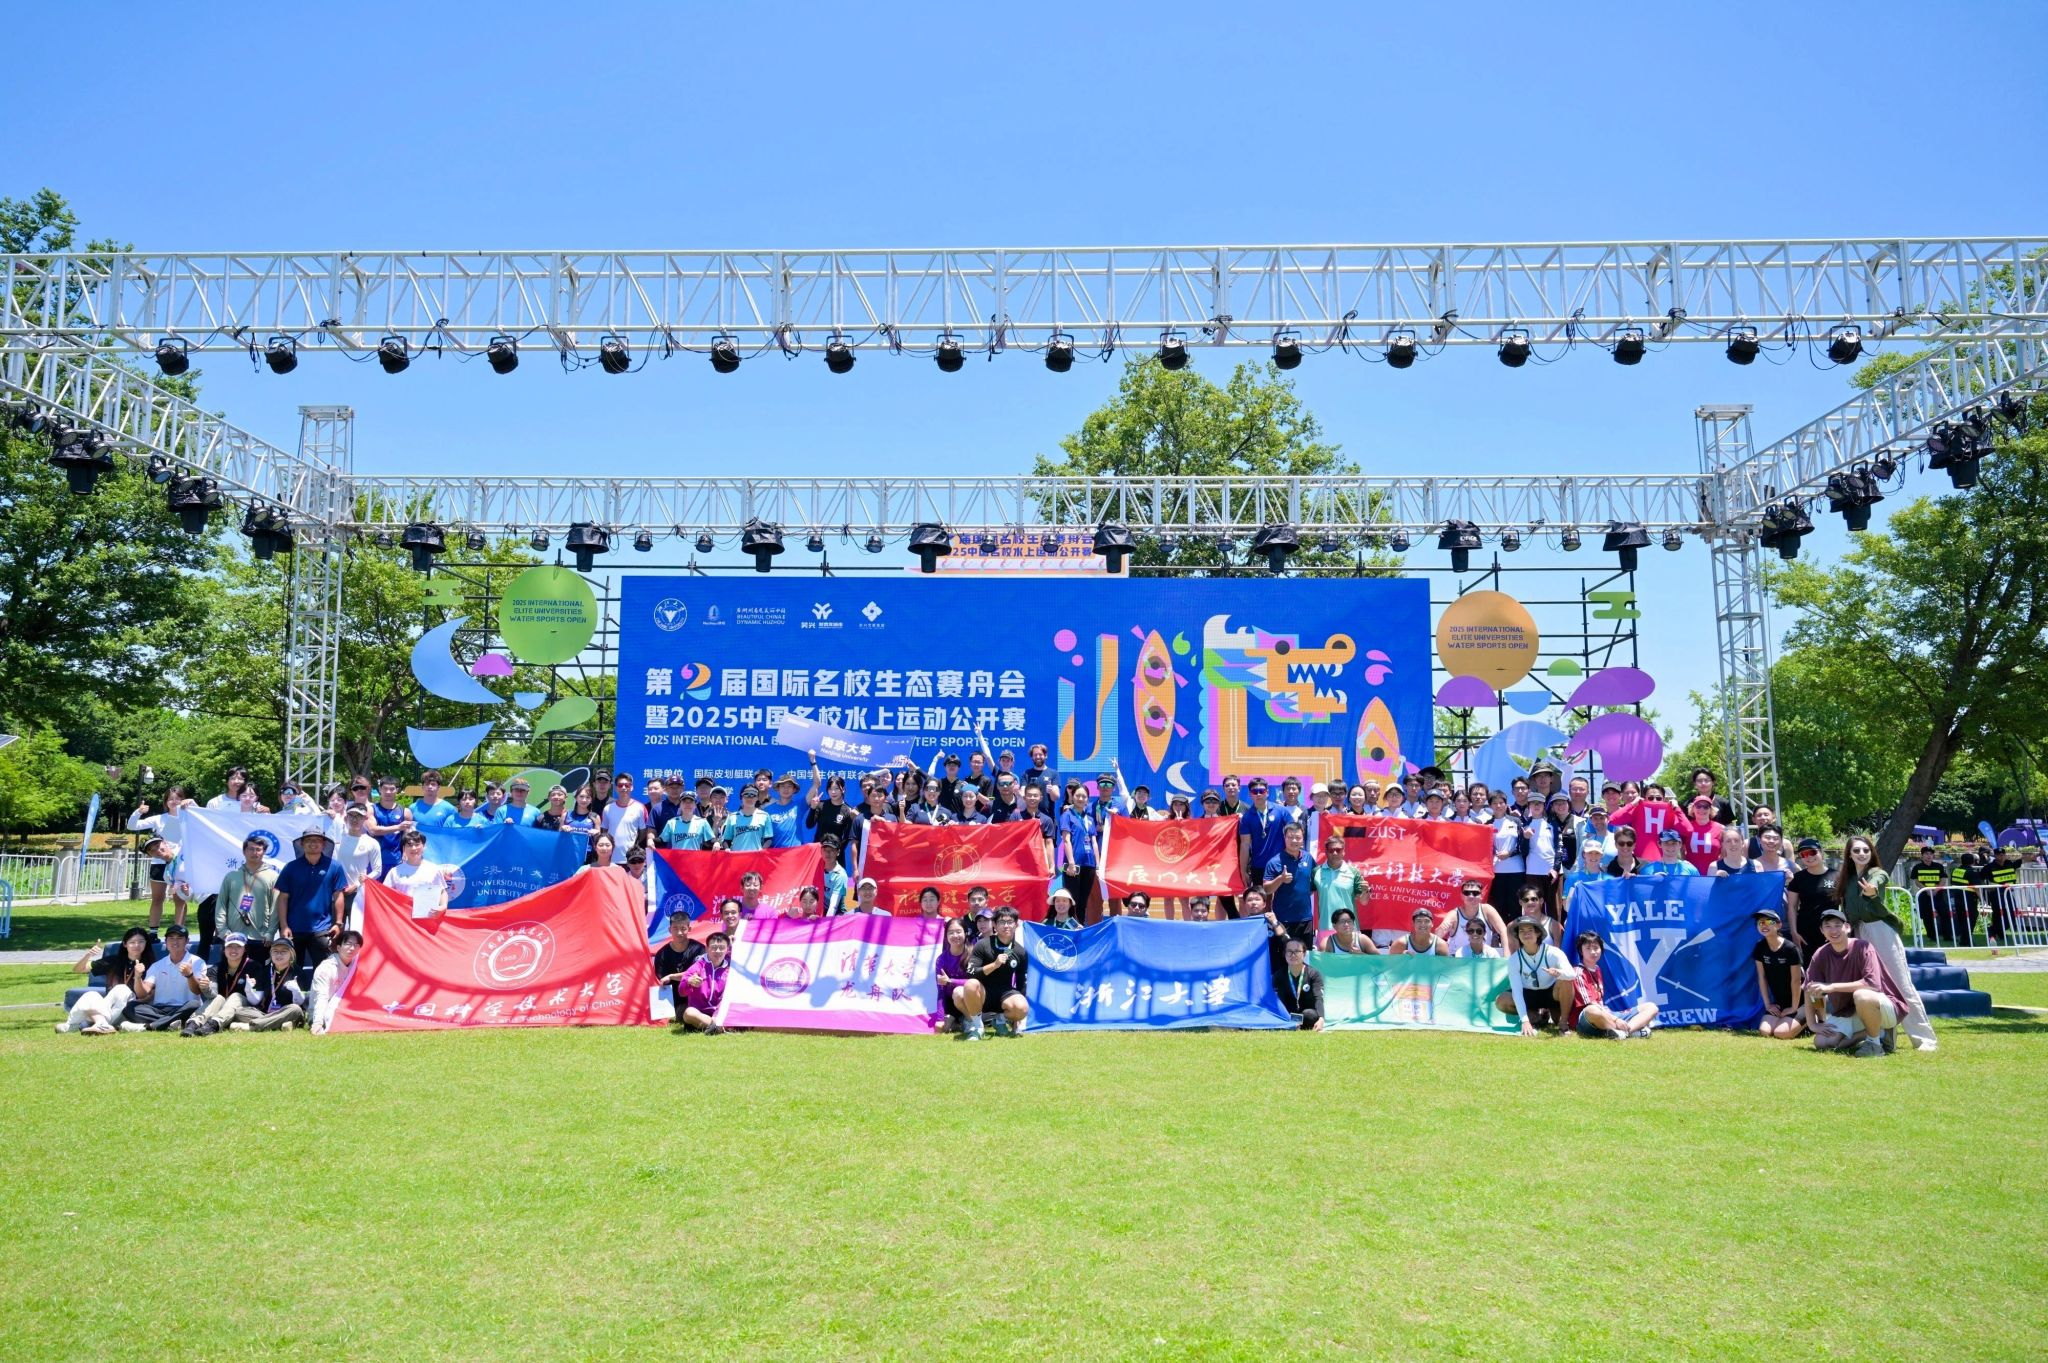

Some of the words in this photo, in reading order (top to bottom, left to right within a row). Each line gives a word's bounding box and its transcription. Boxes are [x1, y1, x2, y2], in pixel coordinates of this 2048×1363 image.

[645, 662, 1026, 701] 第2届国际名校生态赛舟会
[644, 734, 670, 745] 2025
[672, 735, 768, 746] INTERNATIONAL
[914, 737, 938, 747] TER
[992, 737, 1026, 748] OPEN
[821, 736, 873, 756] 南京大学
[787, 769, 869, 780] 中国学生体育联合
[1644, 807, 1666, 834] H
[1368, 826, 1407, 841] ZUST
[1690, 831, 1712, 854] H
[1126, 864, 1222, 886] 厦门大学
[471, 879, 528, 890] UNIVERSIDADE
[477, 888, 522, 898] UNIVERSITY
[1389, 886, 1440, 898] UNIVERSITY
[1440, 891, 1452, 899] OF
[1391, 894, 1446, 909] TECHNOLOGY
[1605, 899, 1686, 926] YALE
[1610, 928, 1687, 1006] Y
[382, 972, 624, 1019] 中国科学技术大学
[580, 1004, 590, 1013] of
[1653, 1008, 1718, 1025] CREW
